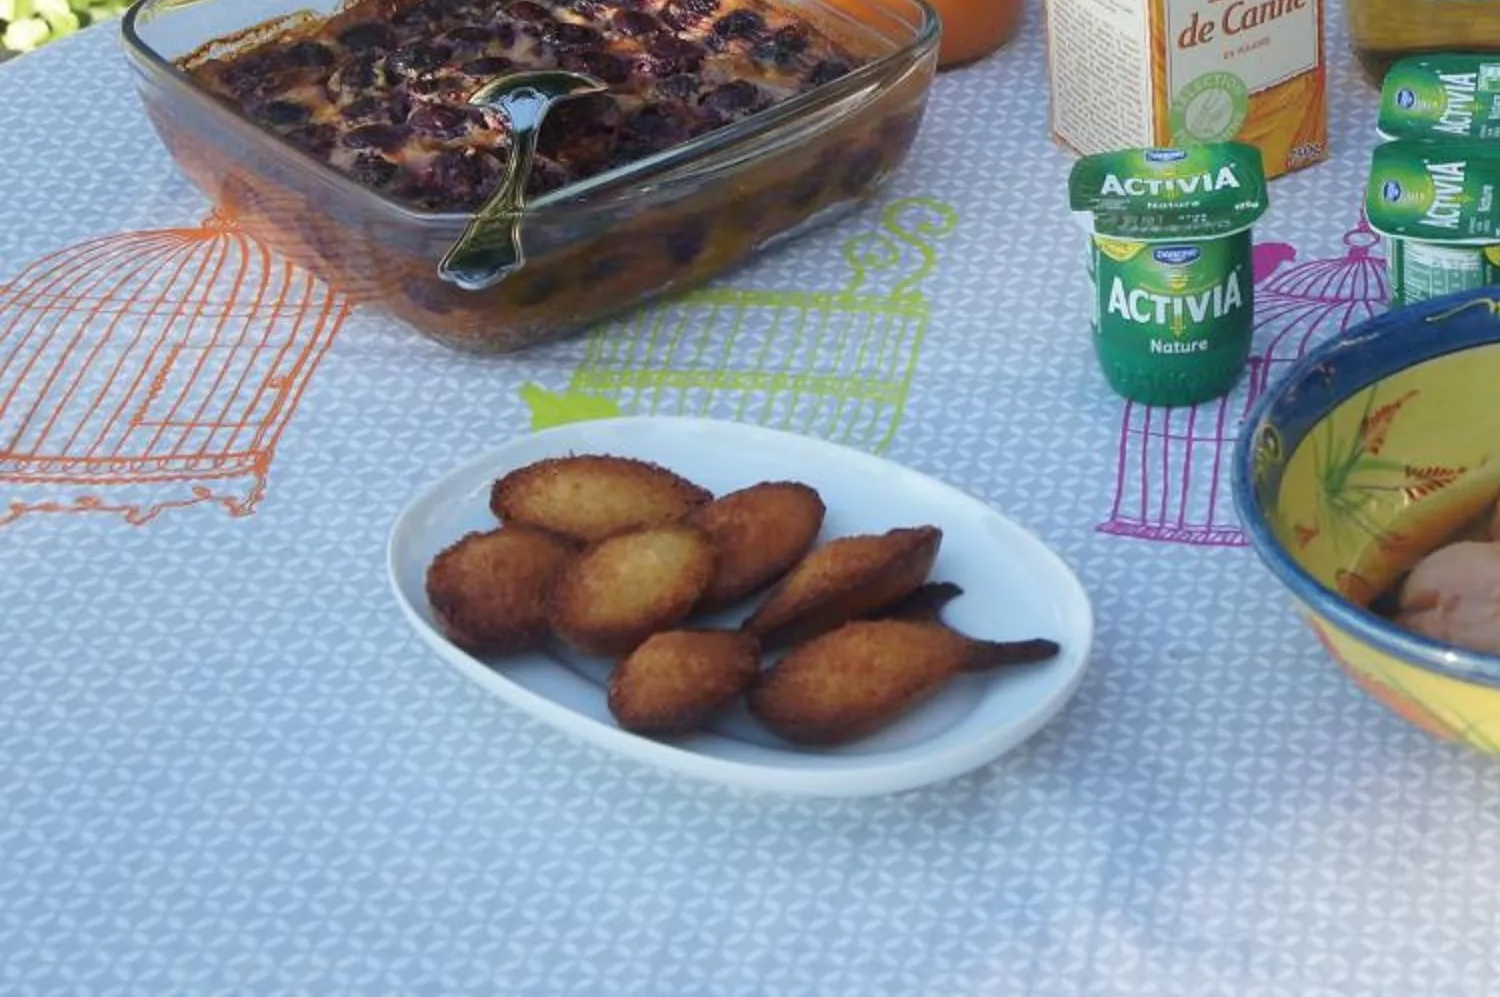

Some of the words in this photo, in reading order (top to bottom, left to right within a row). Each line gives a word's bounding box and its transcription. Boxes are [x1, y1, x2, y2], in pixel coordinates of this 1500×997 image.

[1178, 10, 1216, 51] de
[1431, 73, 1477, 136] ACTIVIA
[1101, 166, 1240, 196] ACTIVIA
[1418, 160, 1467, 229] ACTIVIA
[1108, 271, 1242, 325] ACTIVIA
[1151, 338, 1209, 355] Nature
